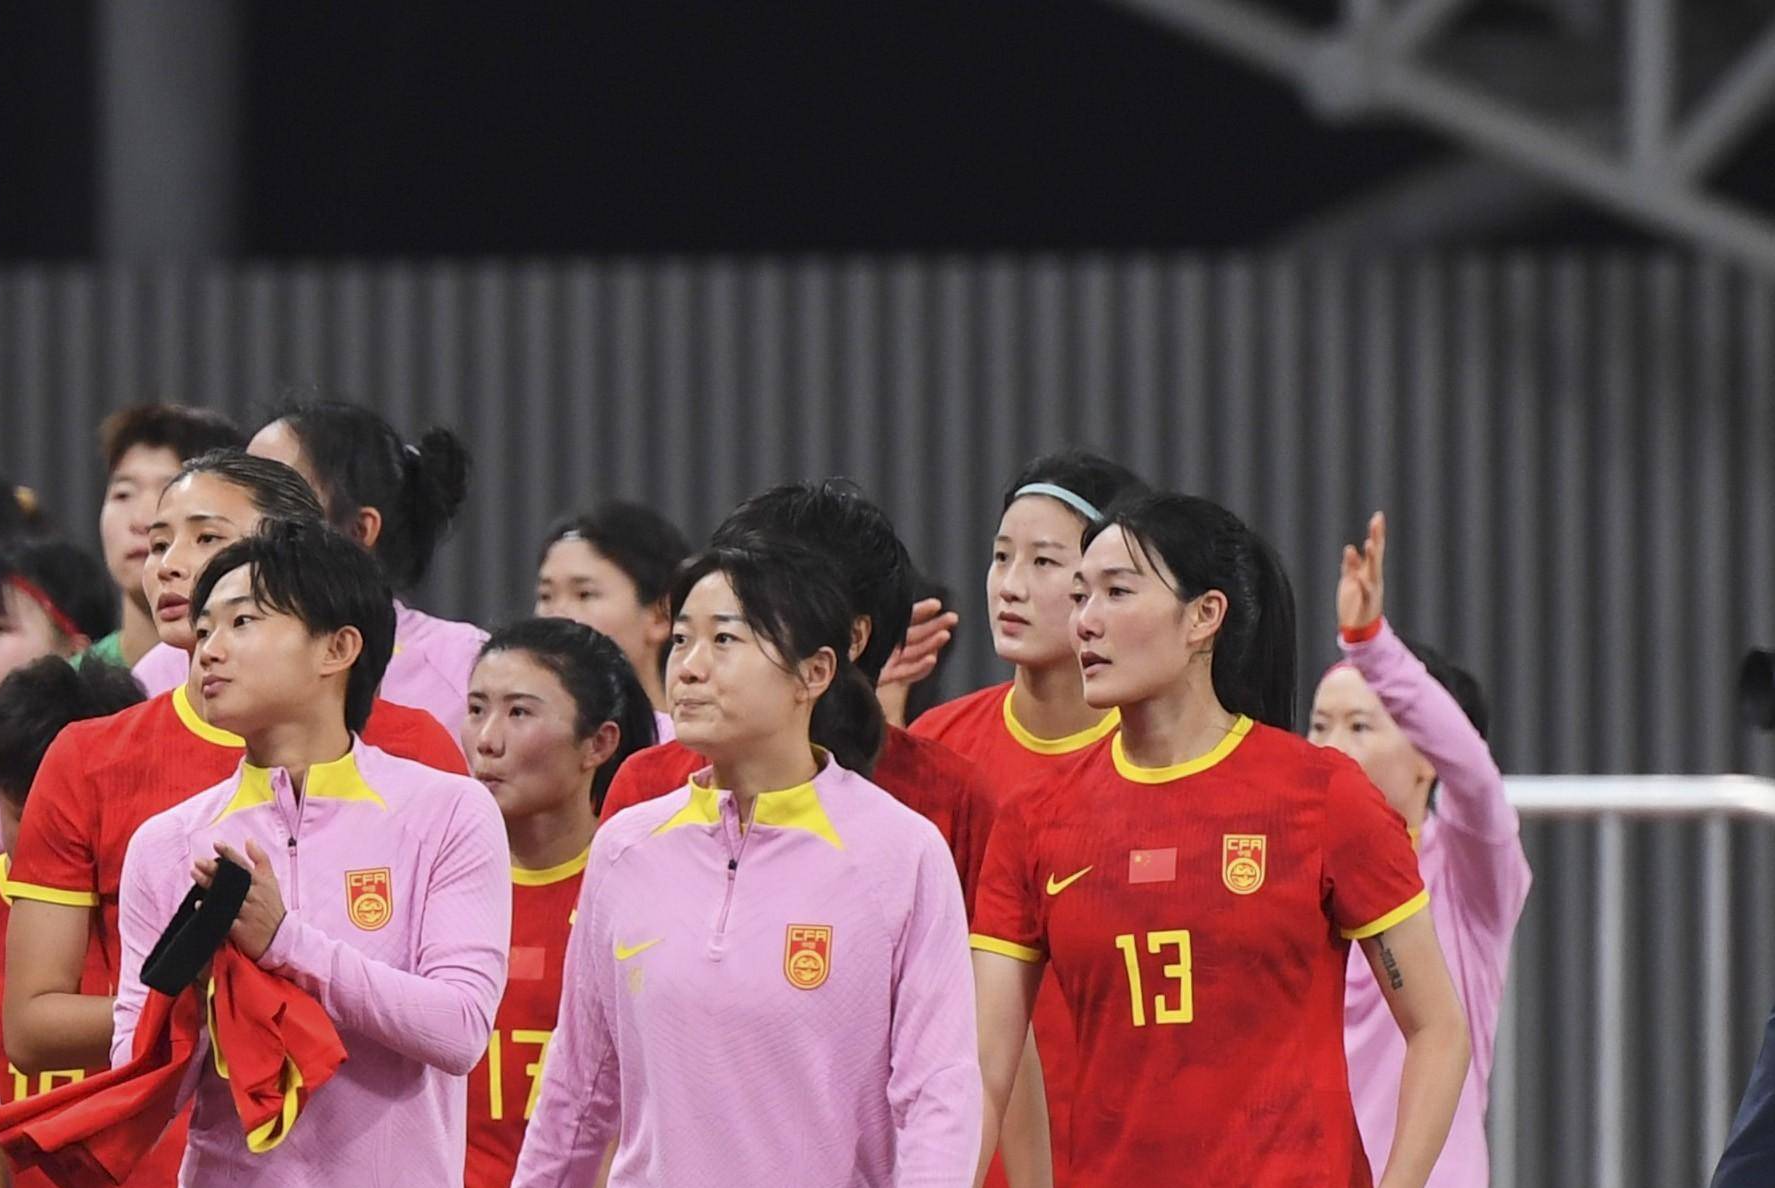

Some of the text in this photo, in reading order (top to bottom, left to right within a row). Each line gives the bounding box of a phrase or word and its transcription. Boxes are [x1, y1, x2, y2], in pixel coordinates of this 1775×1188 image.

[1228, 839, 1262, 851] CFA
[351, 873, 386, 887] CFA
[792, 930, 827, 942] CFA
[1115, 929, 1193, 1027] 13
